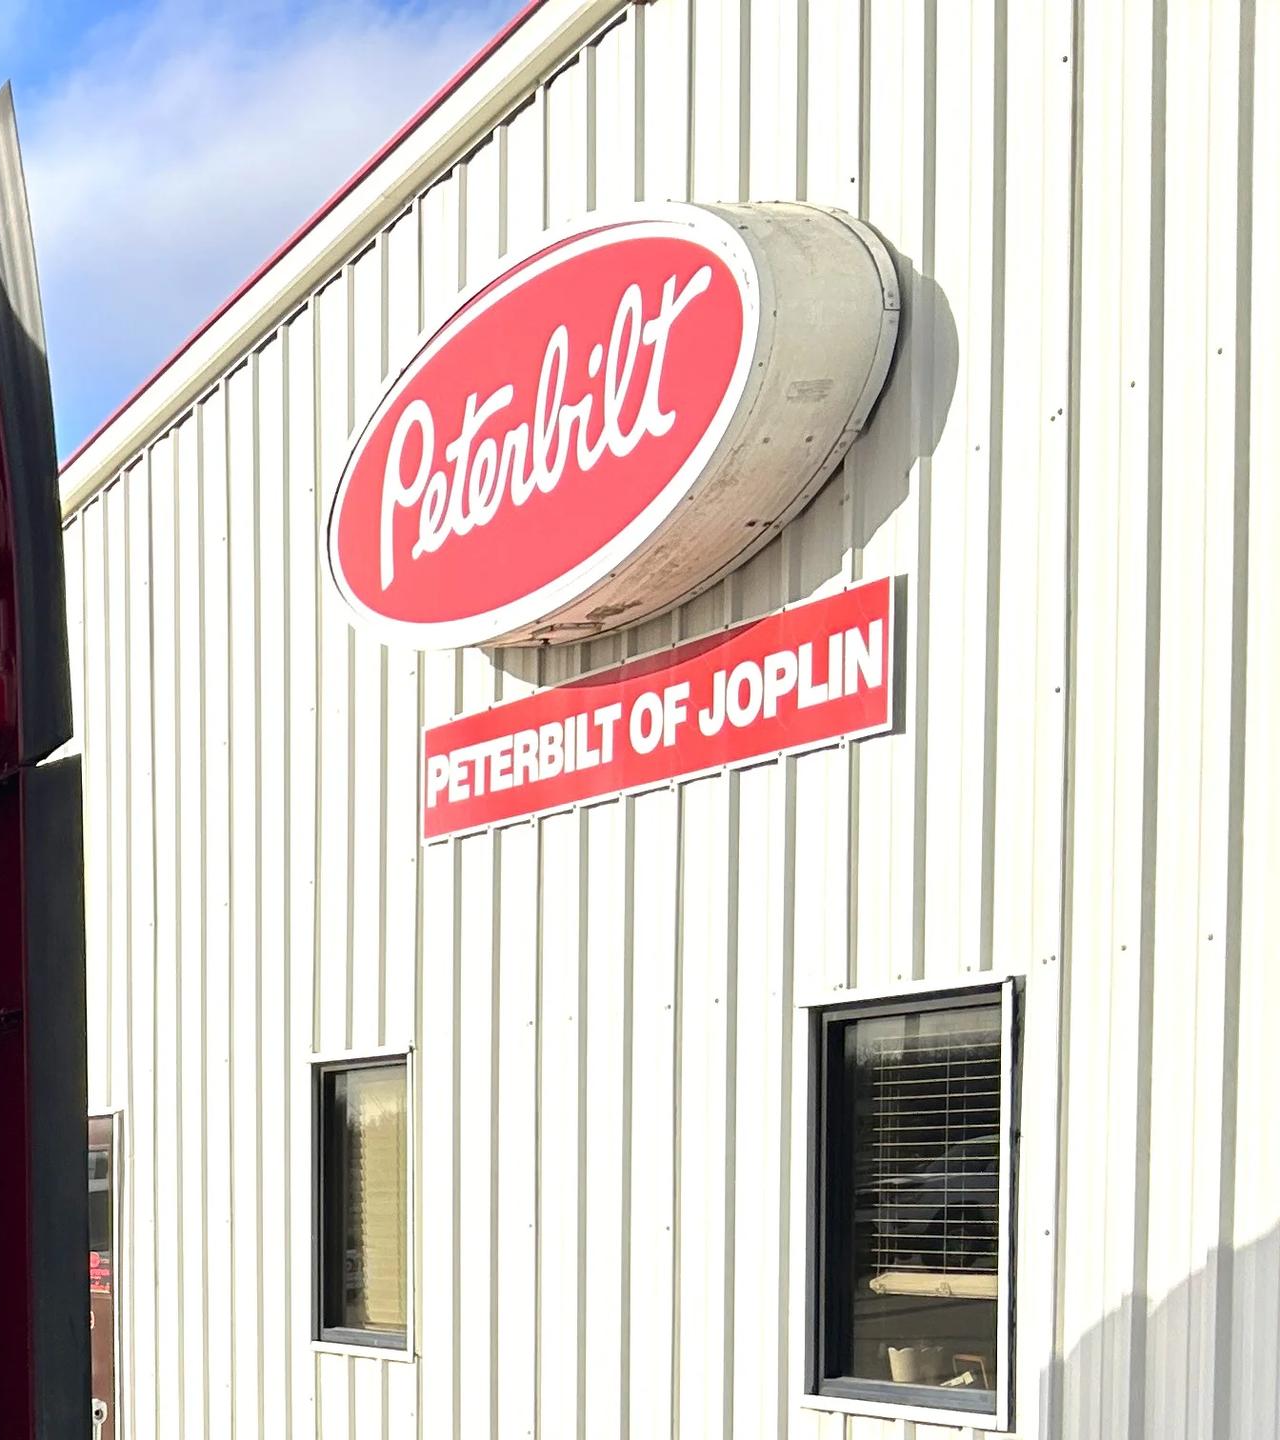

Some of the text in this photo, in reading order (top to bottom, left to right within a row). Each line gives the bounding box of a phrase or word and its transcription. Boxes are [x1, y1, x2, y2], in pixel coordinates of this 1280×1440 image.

[379, 264, 712, 592] Peterbilt
[426, 618, 884, 809] PETERBILT OF JOPLIN
